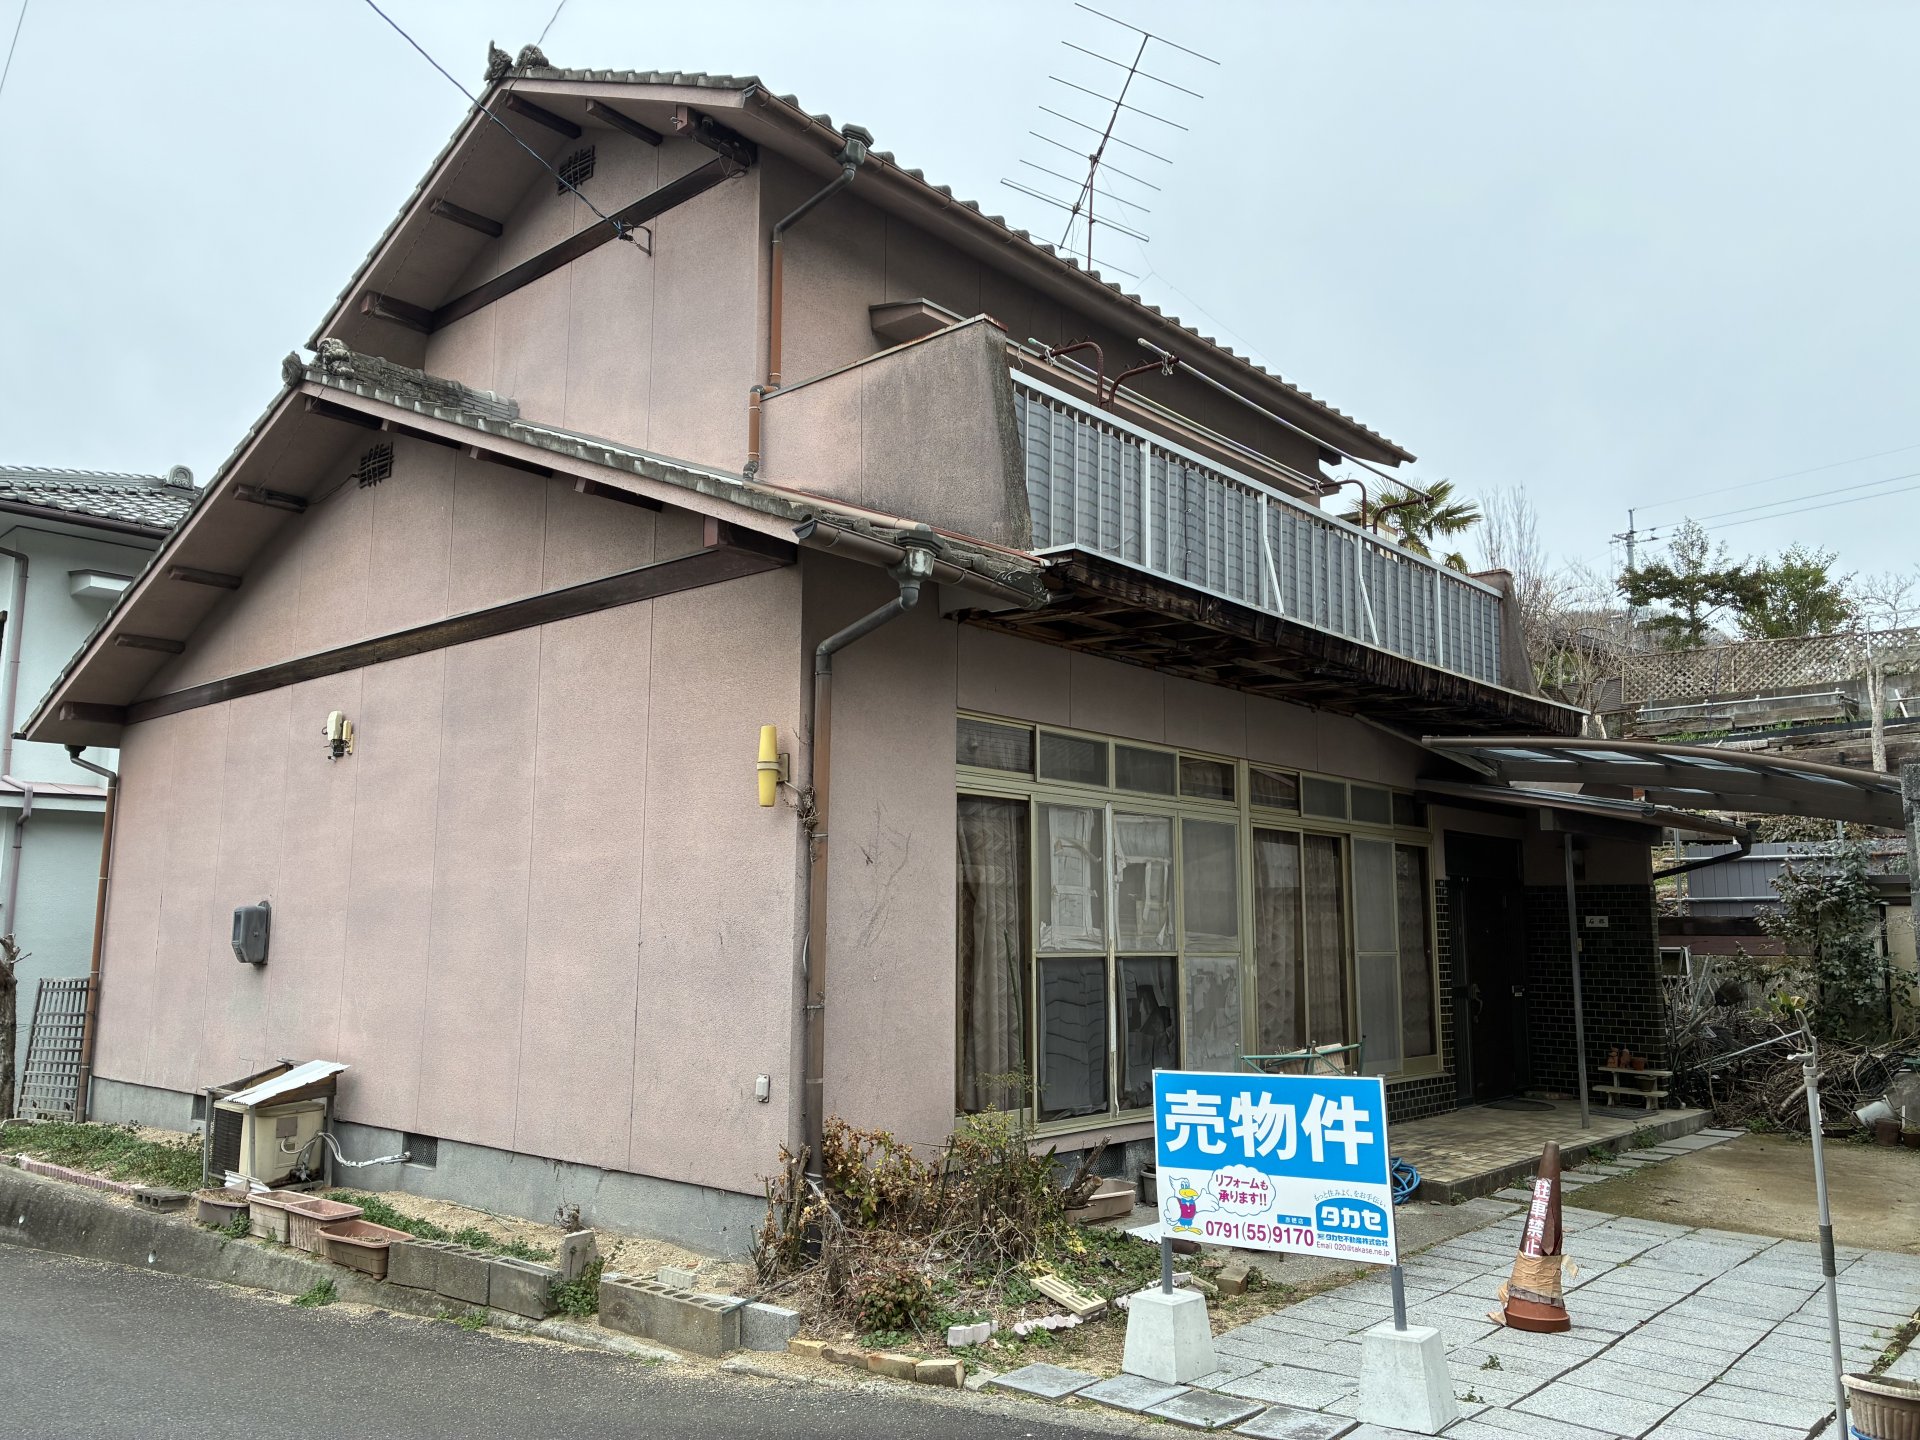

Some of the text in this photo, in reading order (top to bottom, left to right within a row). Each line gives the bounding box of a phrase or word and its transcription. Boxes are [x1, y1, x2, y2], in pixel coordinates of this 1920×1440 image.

[1165, 1089, 1374, 1165] 売物件
[1215, 1174, 1269, 1191] リフォームも
[1321, 1206, 1381, 1231] タカセ
[1206, 1220, 1314, 1246] 0791(55)9170
[1316, 1241, 1390, 1257] Email 020@takase.ne.jp
